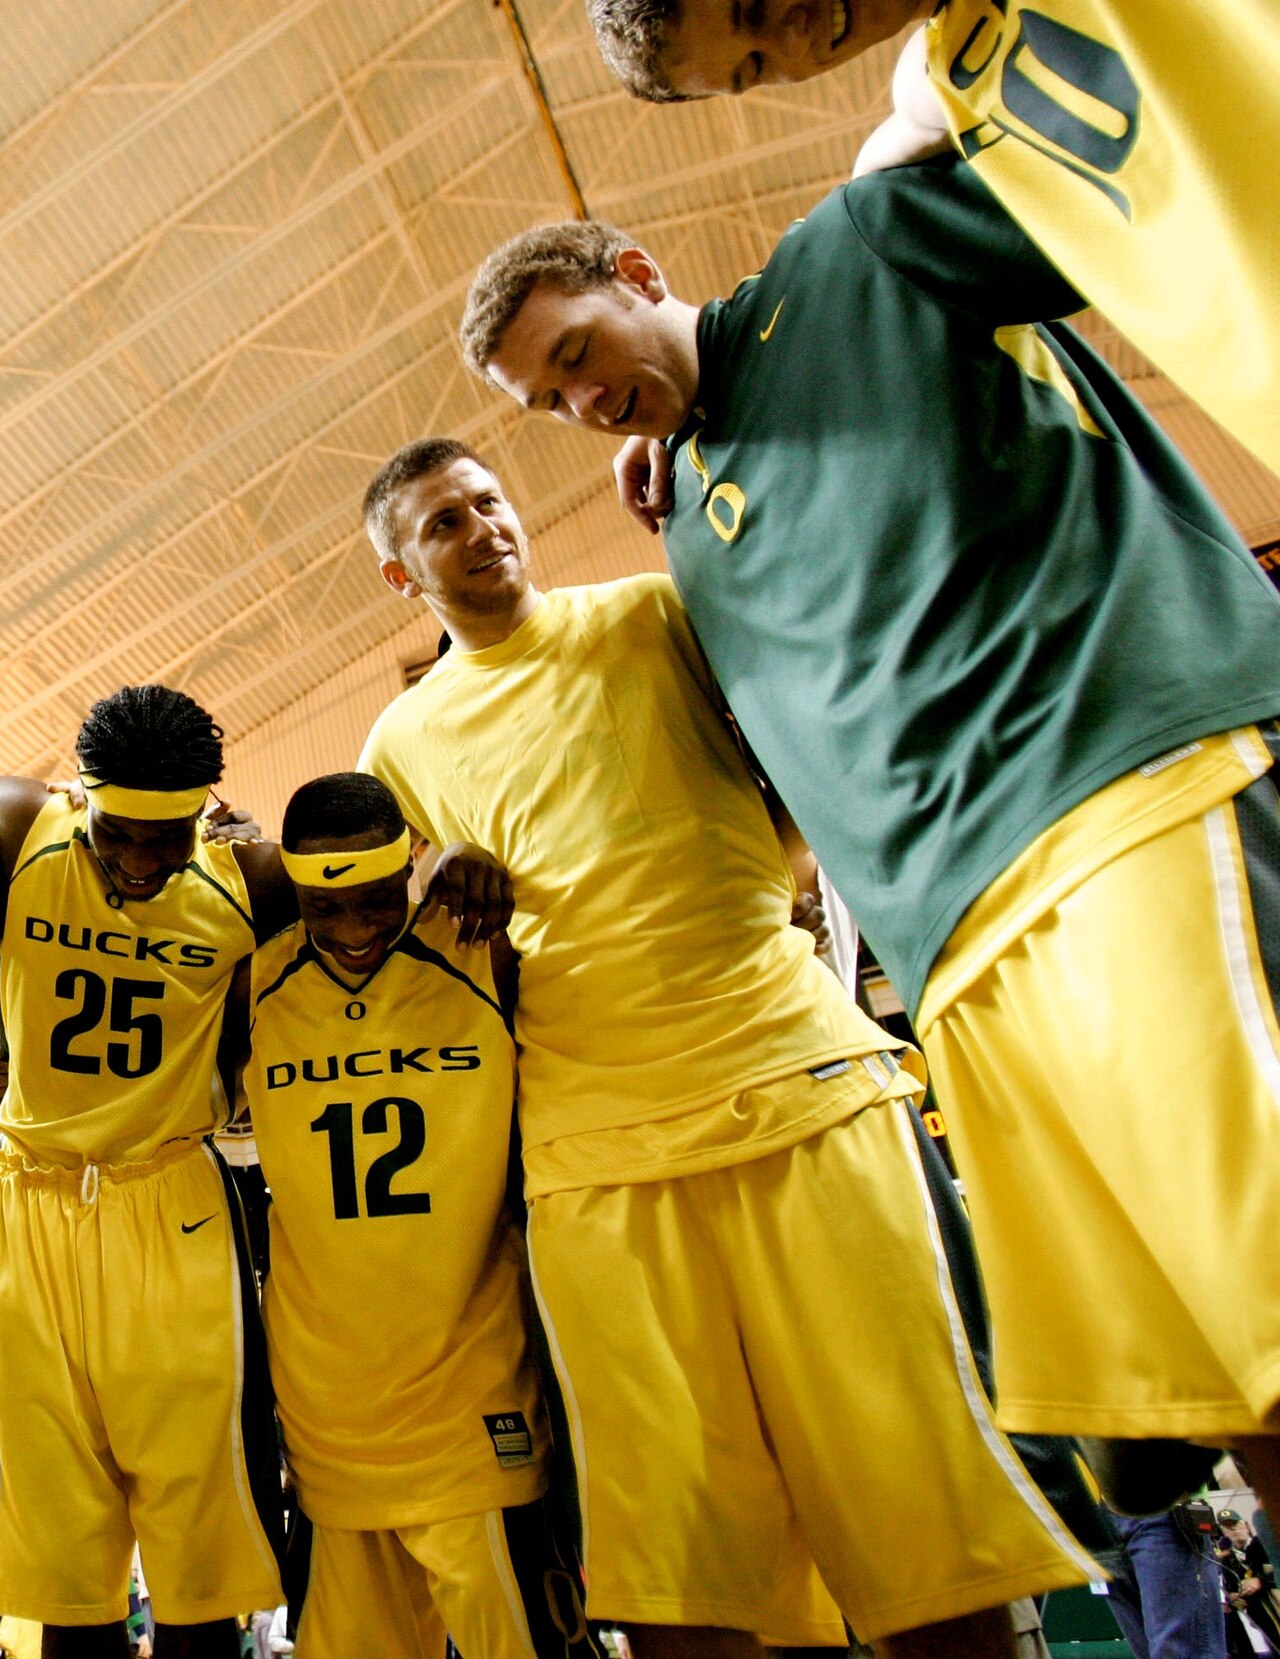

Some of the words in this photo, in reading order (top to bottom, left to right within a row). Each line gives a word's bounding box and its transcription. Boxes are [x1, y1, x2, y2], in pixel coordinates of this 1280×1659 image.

[25, 916, 218, 968] DUCKS
[50, 968, 166, 1079] 25
[344, 1001, 367, 1020] O
[266, 1045, 481, 1090] DUCKS
[310, 1096, 432, 1220] 12
[495, 1418, 516, 1431] 48
